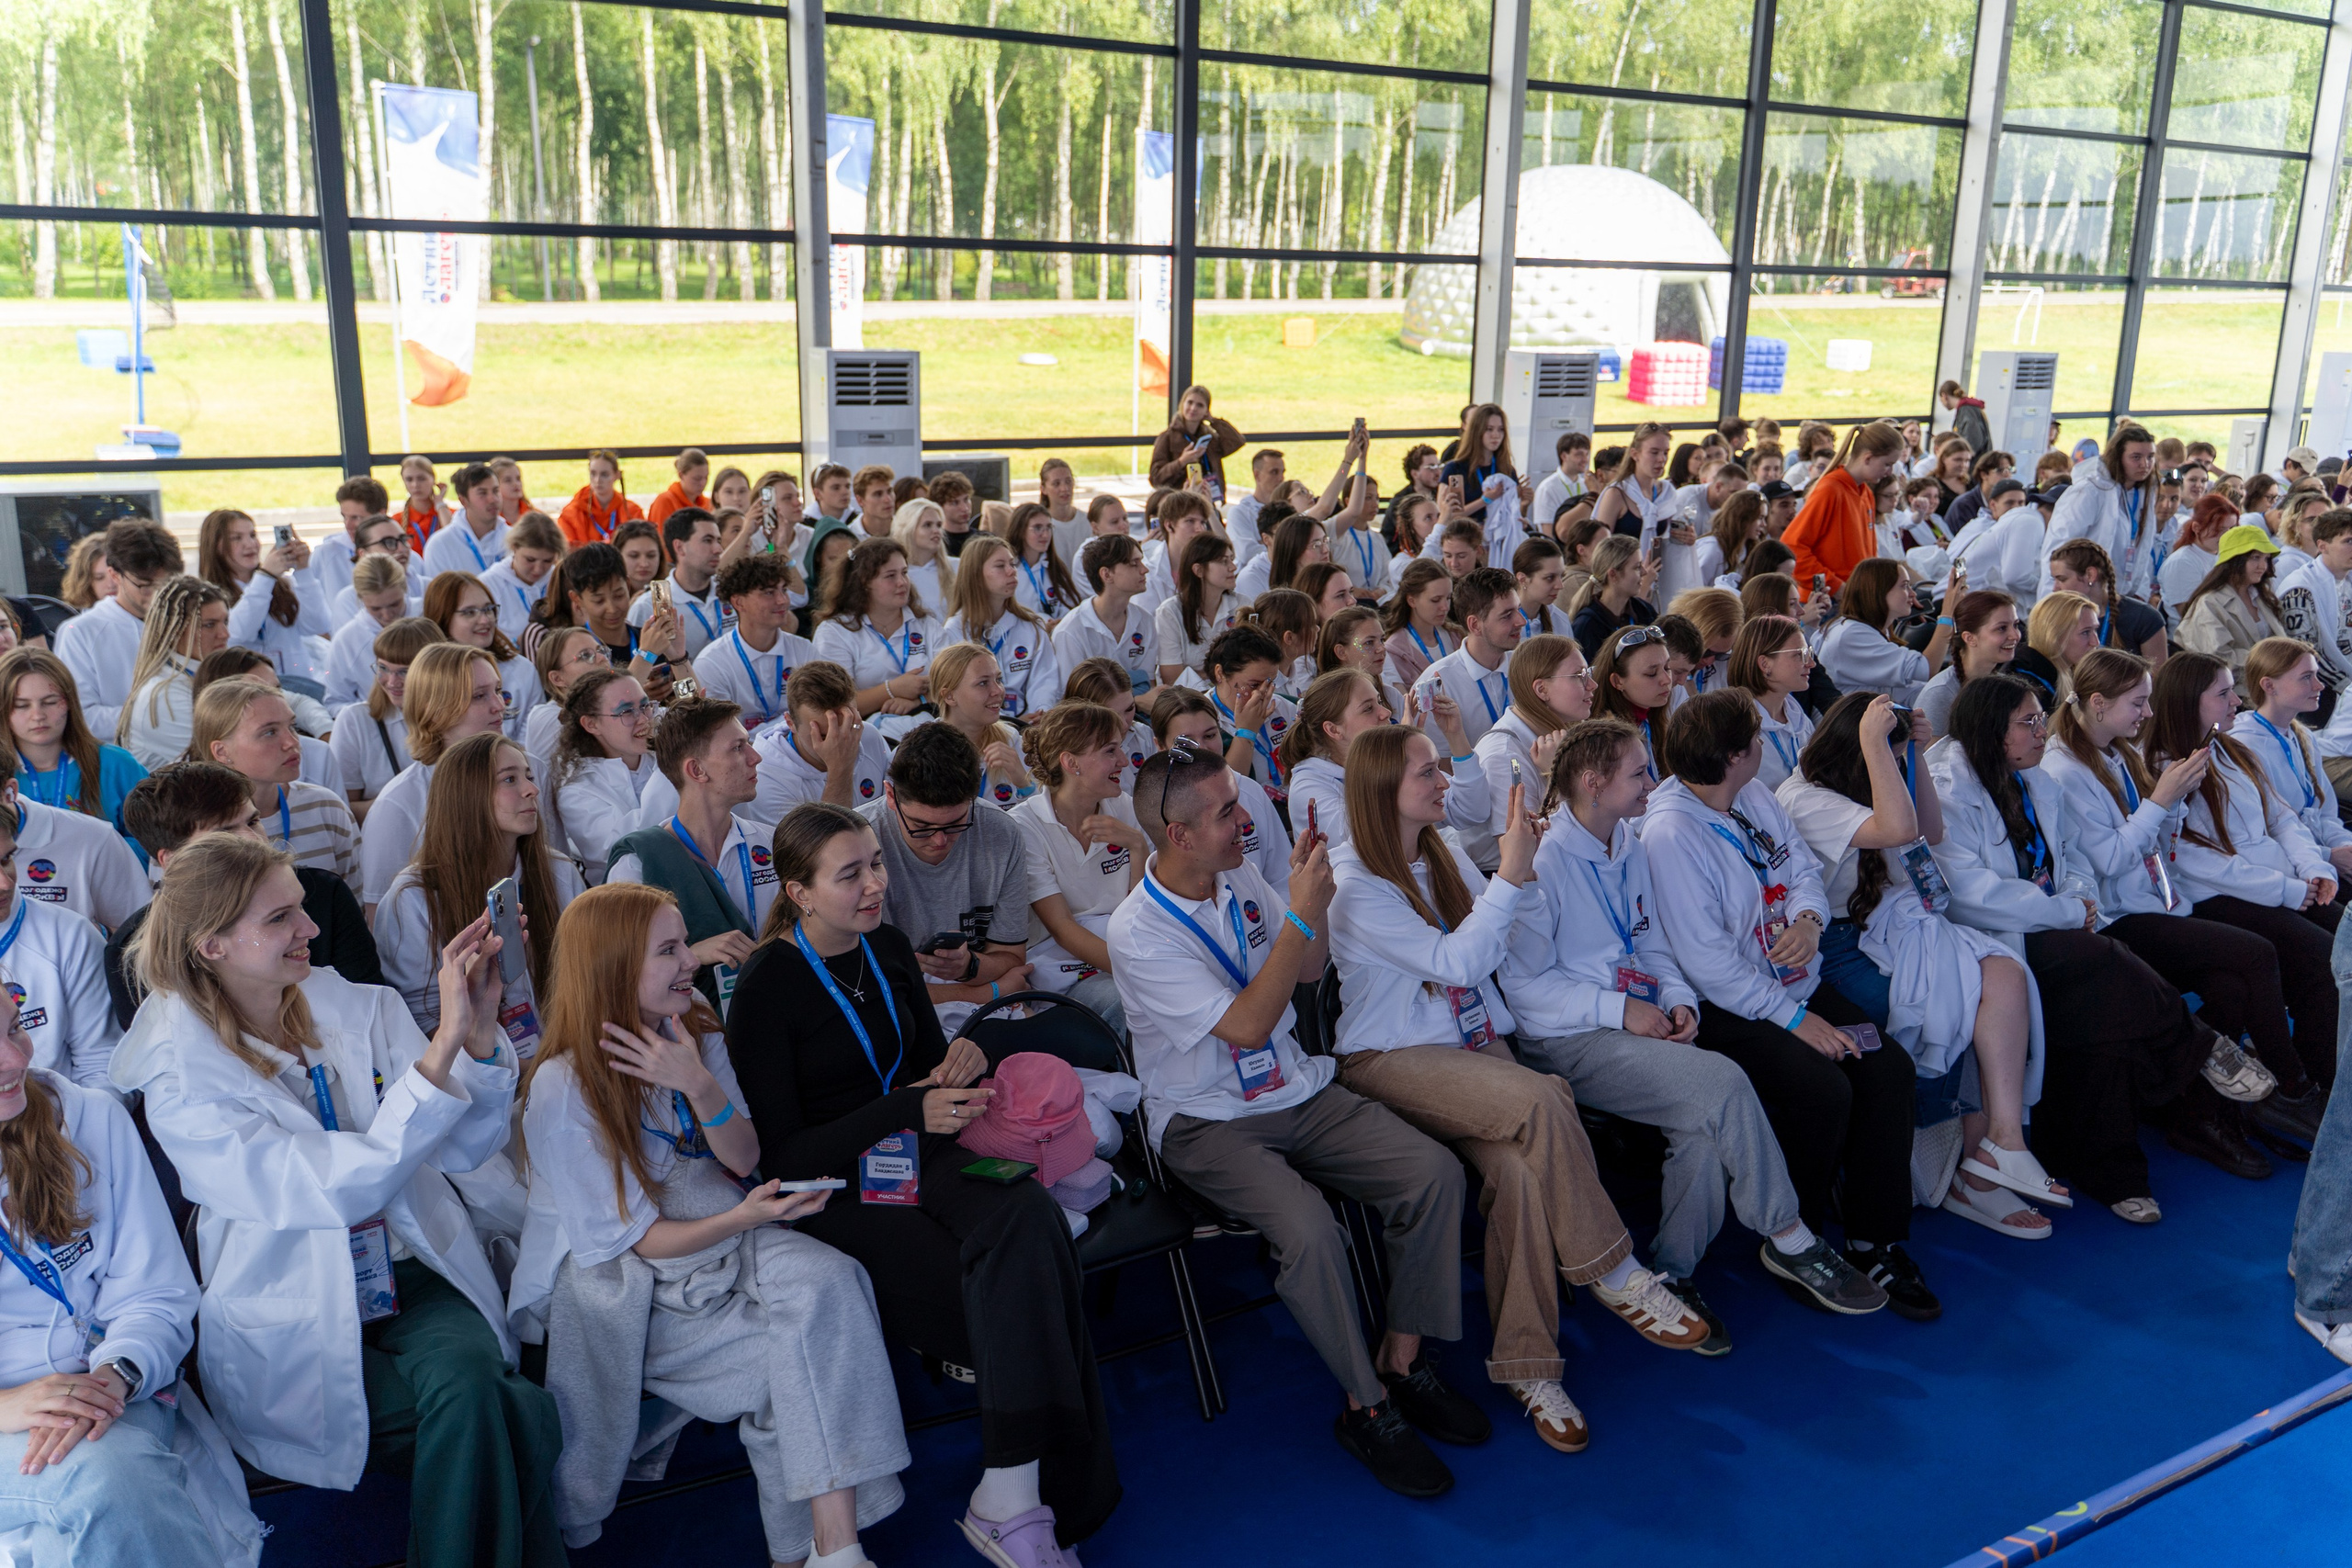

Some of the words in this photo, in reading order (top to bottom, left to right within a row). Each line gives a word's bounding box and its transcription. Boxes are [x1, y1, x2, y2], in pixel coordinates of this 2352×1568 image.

[423, 231, 436, 304] Летни
[2286, 614, 2303, 630] 07
[1104, 856, 1129, 873] МОСКВ
